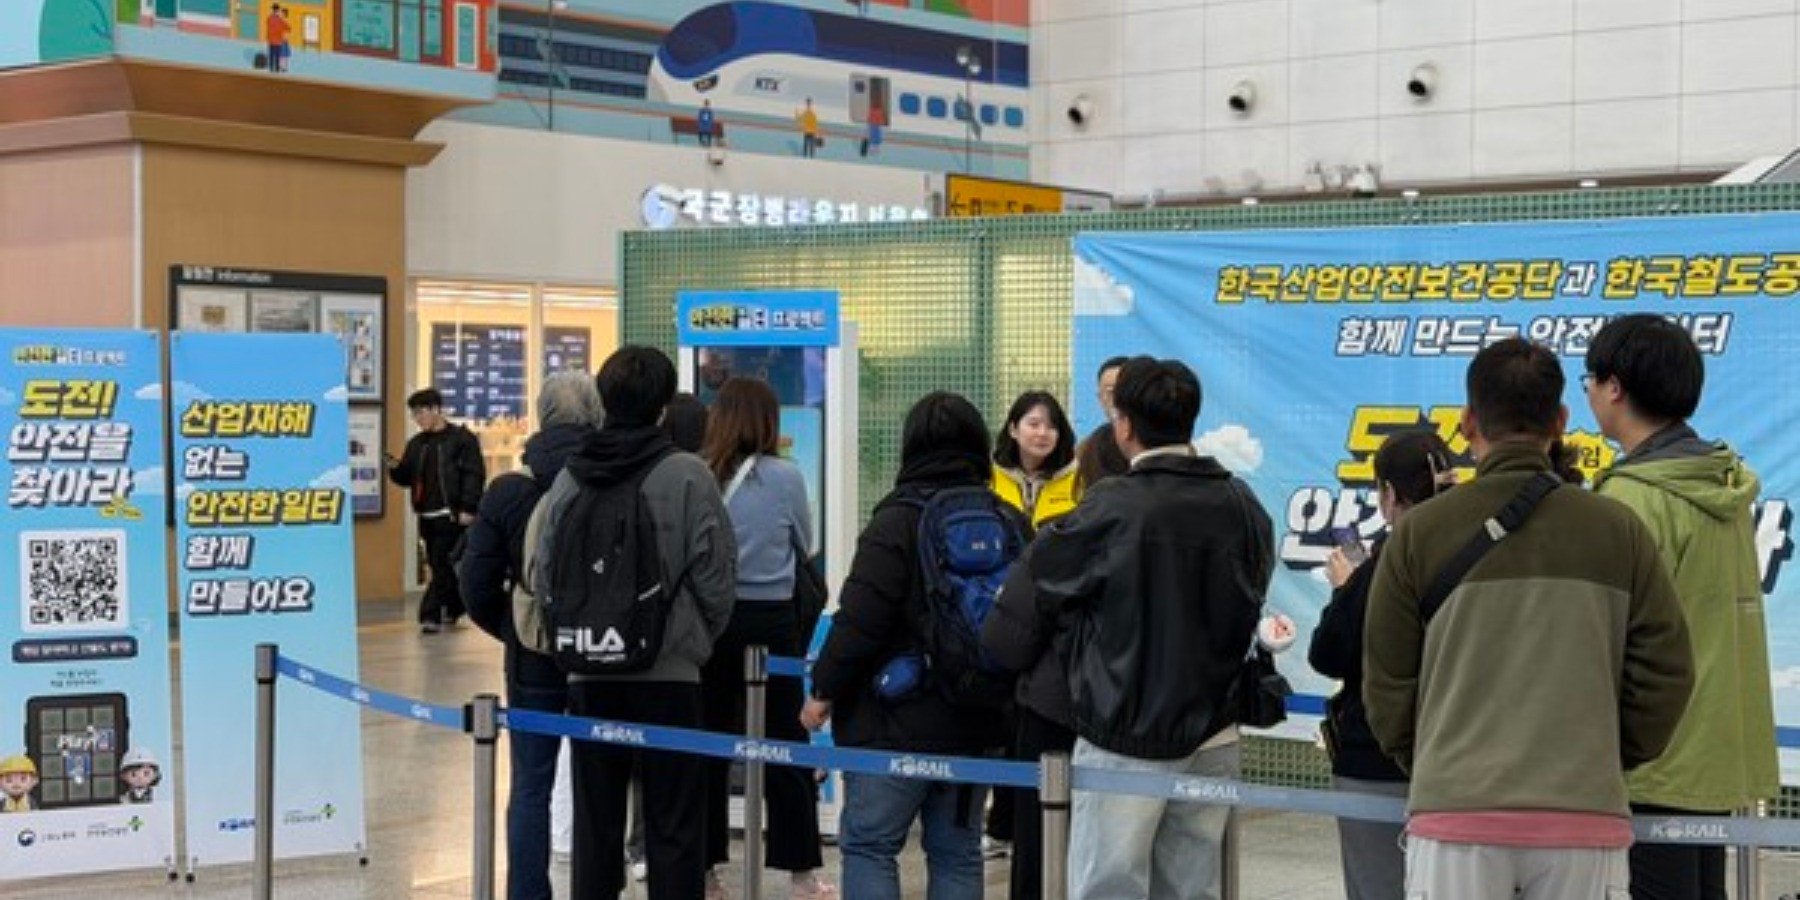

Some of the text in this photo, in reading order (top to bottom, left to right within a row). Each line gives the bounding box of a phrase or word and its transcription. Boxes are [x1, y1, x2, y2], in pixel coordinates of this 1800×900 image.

[1216, 252, 1800, 303] 한국산업안전보건공단과 한국철도공
[1336, 315, 1408, 357] 함께
[19, 379, 119, 419] 도전!
[181, 402, 314, 437] 산업재해
[8, 422, 133, 463] 안전을
[184, 446, 247, 479] 없는
[8, 466, 134, 507] 찾아라
[186, 534, 252, 568] 함께
[187, 577, 313, 615] 만들어요
[556, 627, 625, 652] FILA
[735, 740, 792, 763] KORAIL
[890, 755, 954, 778] KORAIL
[1172, 780, 1240, 800] KORAIL
[1649, 818, 1728, 839] KORAIL
